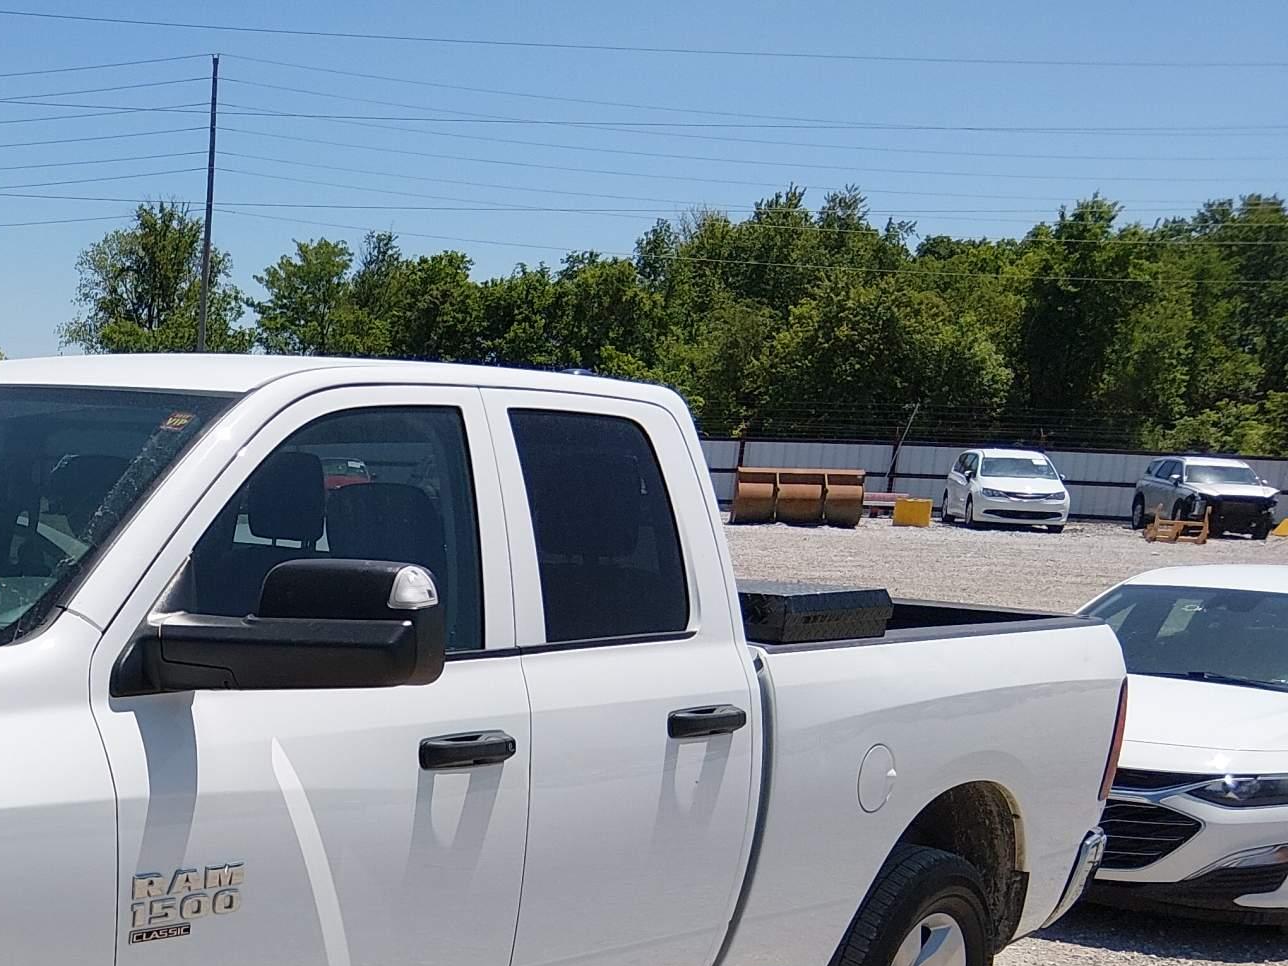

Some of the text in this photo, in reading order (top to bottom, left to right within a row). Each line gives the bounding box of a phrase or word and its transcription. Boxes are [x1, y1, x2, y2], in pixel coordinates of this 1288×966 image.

[166, 416, 188, 426] VIP
[131, 862, 244, 900] RAM
[131, 887, 241, 928] 1500
[131, 924, 191, 943] CLASSIC
